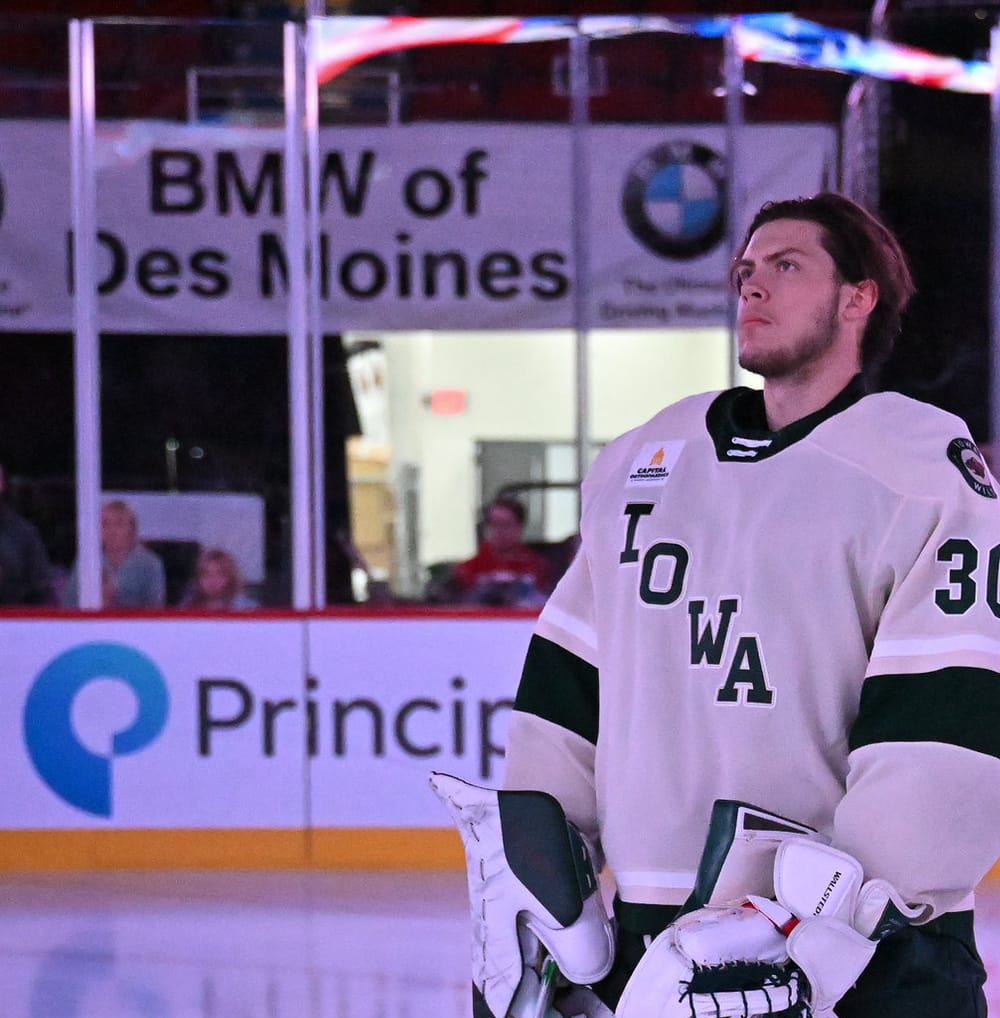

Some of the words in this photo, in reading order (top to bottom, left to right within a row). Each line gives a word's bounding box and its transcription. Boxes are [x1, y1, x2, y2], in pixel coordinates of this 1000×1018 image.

[150, 149, 376, 217] BMW
[403, 149, 489, 219] of
[67, 229, 231, 299] Des
[258, 231, 569, 301] Moines
[619, 501, 776, 707] IOWA
